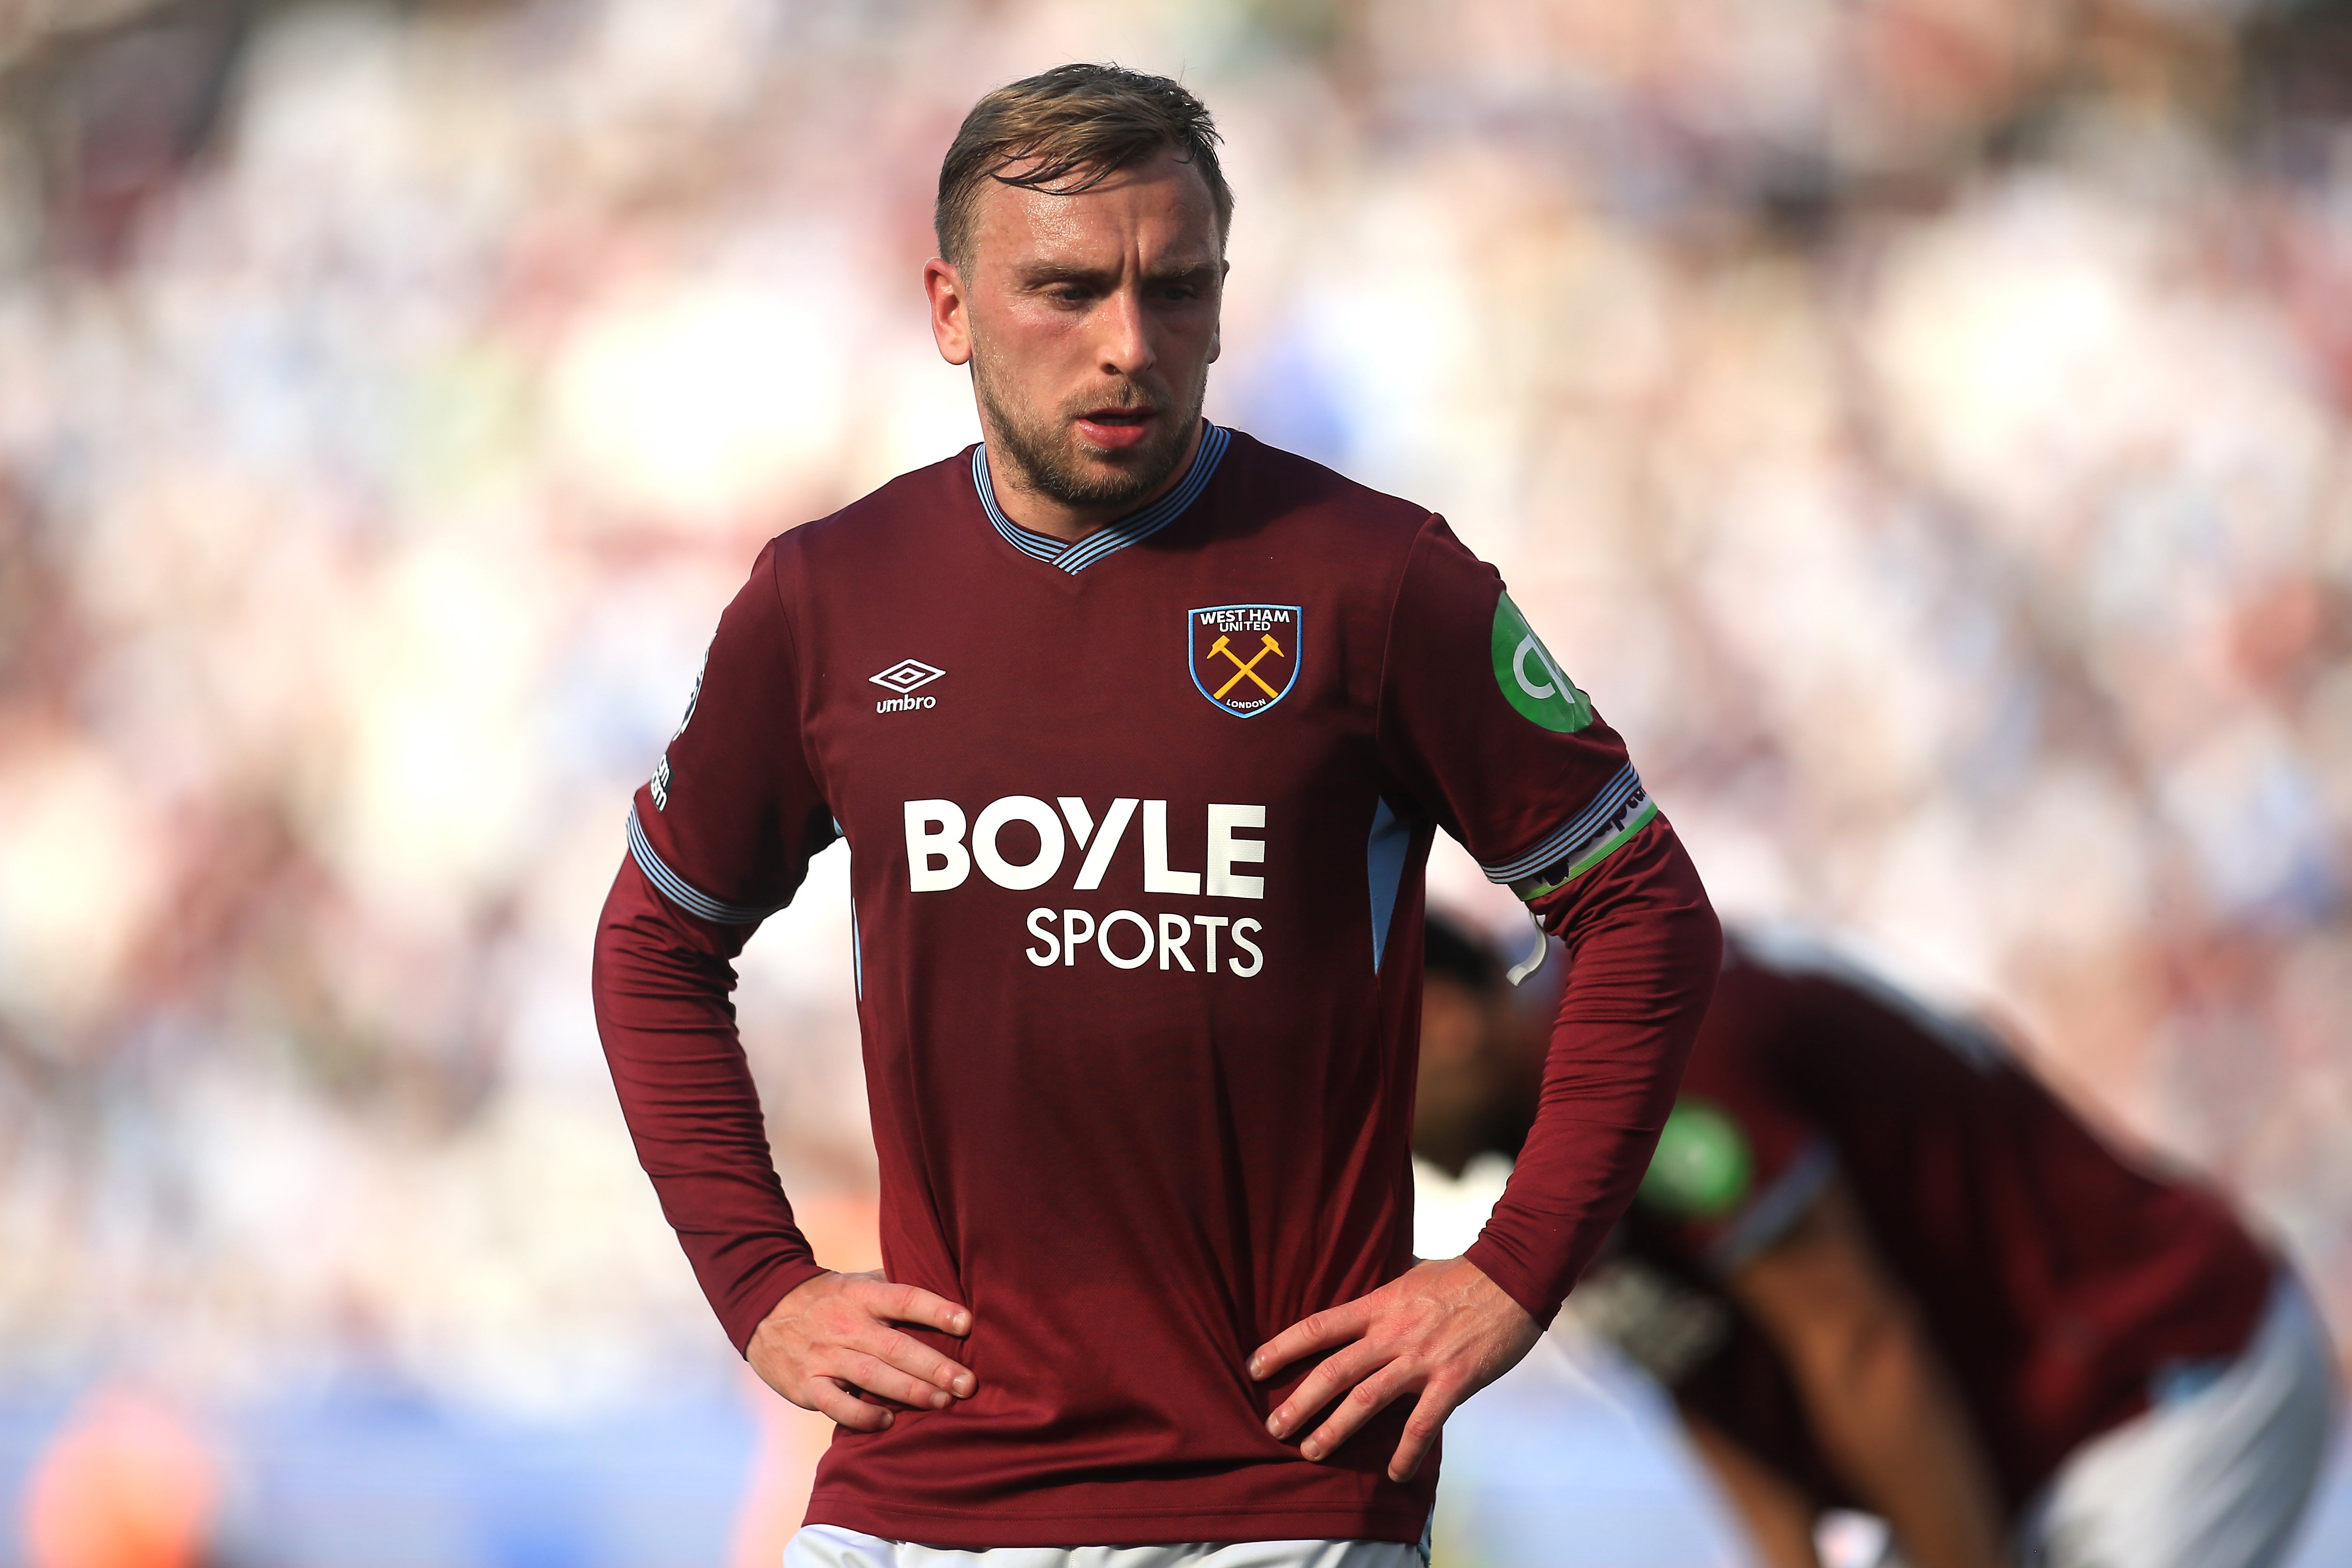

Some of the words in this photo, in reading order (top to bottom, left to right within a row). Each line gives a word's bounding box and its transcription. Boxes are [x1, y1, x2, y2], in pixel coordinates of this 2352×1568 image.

[1200, 610, 1246, 625] WEST
[1249, 609, 1290, 623] HAM
[1219, 621, 1271, 632] UNITED
[876, 694, 936, 713] umbro
[1226, 698, 1266, 708] LONDON
[903, 795, 1266, 899] BOYLE
[1026, 907, 1265, 978] SPORTS
